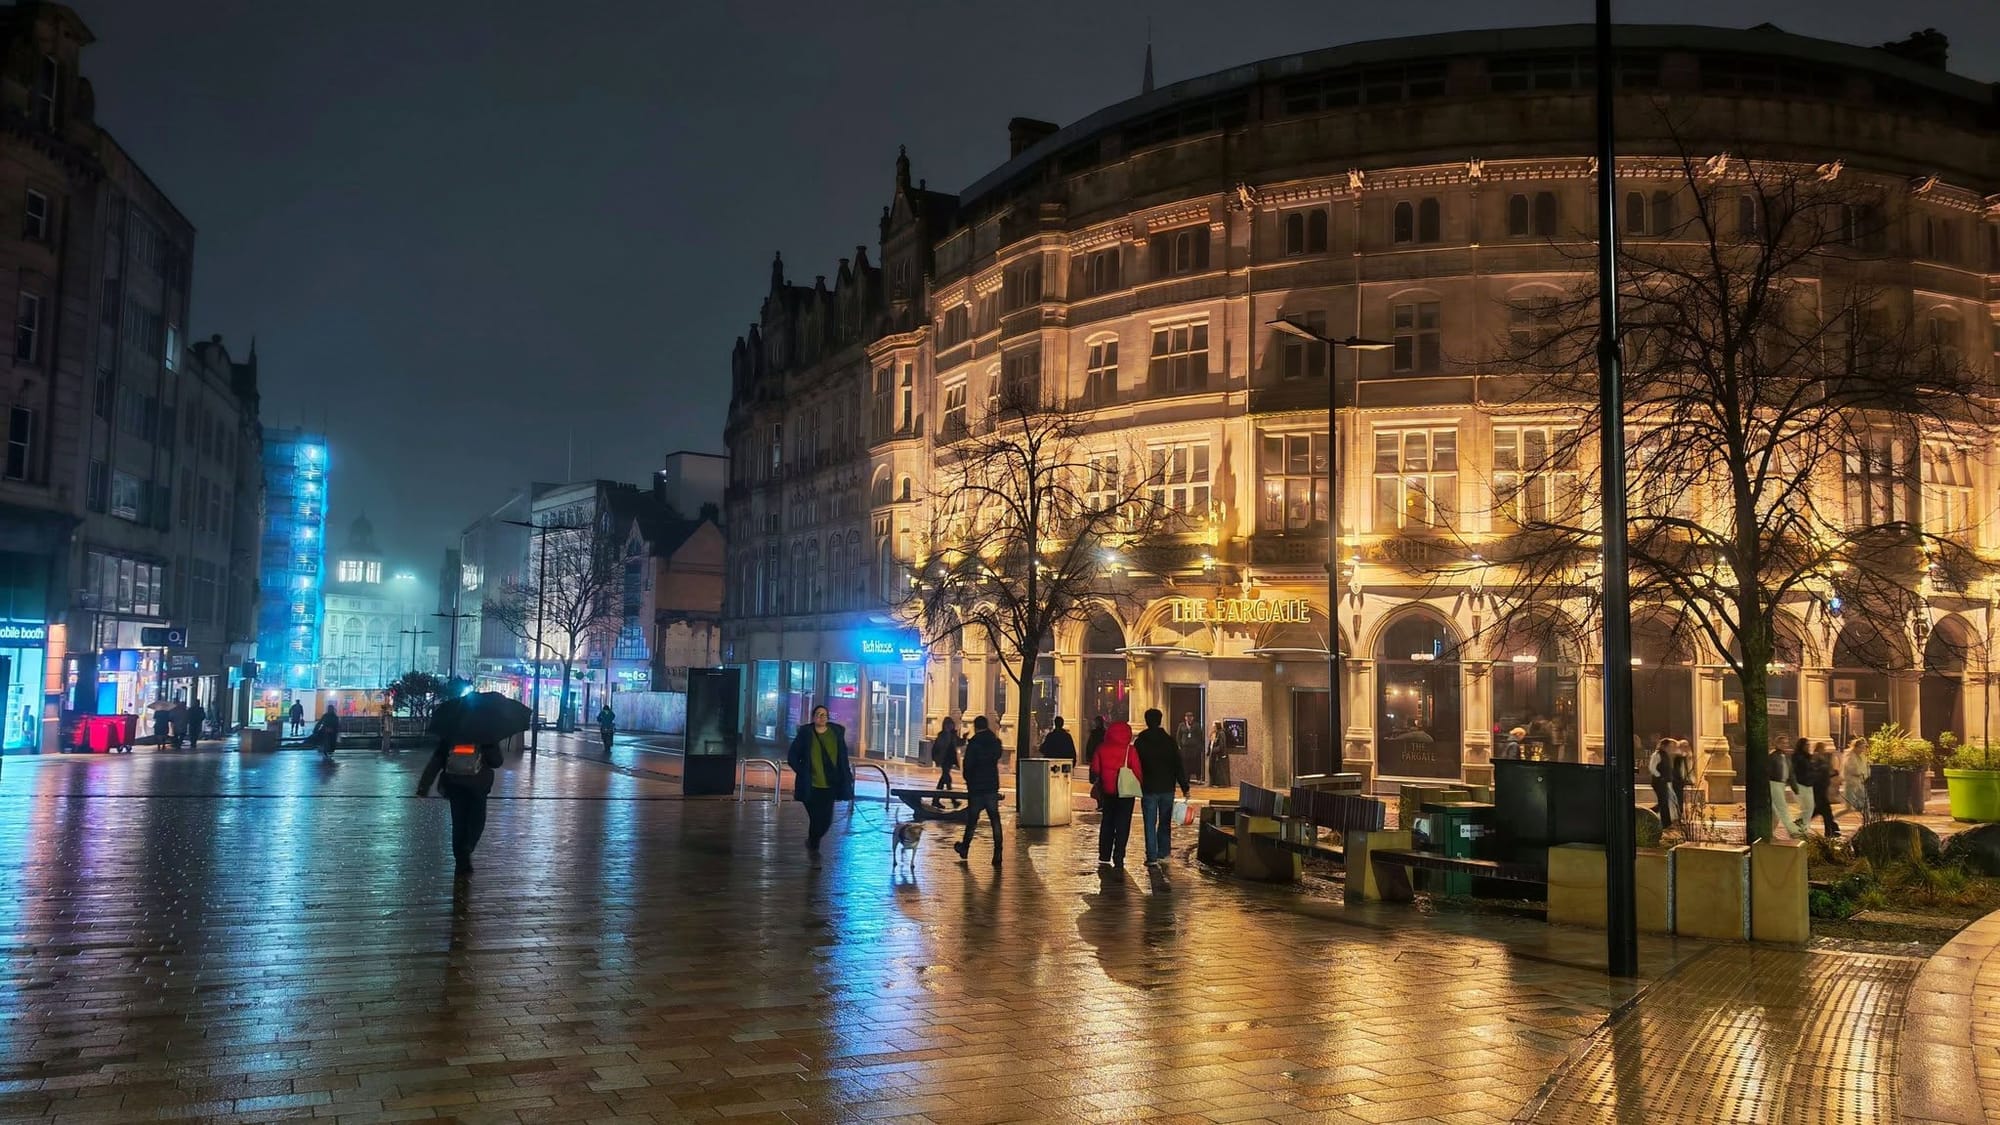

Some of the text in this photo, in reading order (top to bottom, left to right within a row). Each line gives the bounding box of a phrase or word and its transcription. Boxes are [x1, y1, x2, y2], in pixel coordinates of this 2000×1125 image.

[1169, 598, 1310, 623] THE FARGATE
[21, 627, 44, 639] booth
[1411, 743, 1425, 751] THE
[1401, 751, 1438, 762] FARGATE
